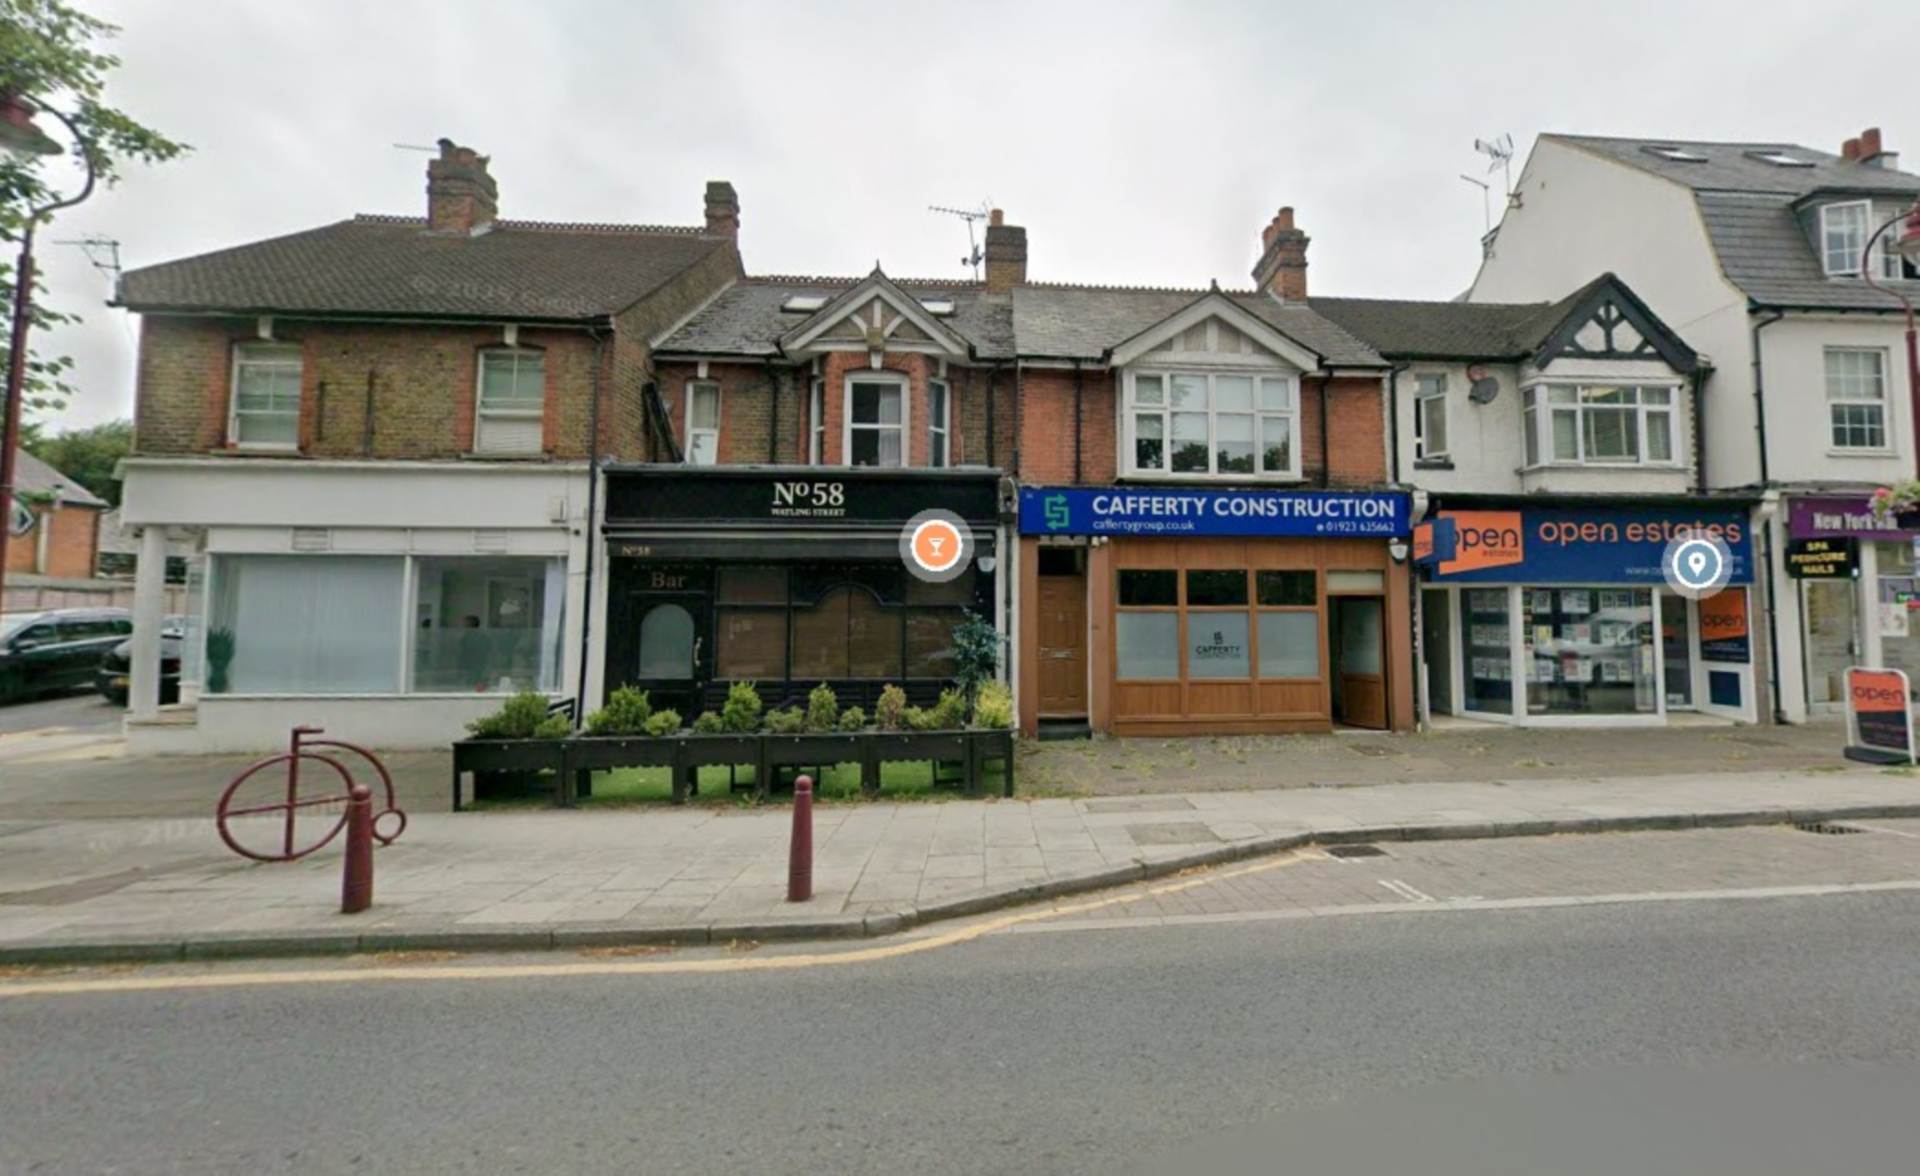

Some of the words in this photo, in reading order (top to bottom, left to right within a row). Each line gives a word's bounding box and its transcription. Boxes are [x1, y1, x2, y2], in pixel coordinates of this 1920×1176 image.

[771, 508, 811, 516] WATLING
[812, 508, 845, 516] STREET
[1092, 495, 1207, 515] CAFFERTY
[1213, 497, 1395, 517] CONSTRUCTION
[1092, 518, 1195, 532] caffertygroup.co.uk
[1326, 521, 1357, 532] 01923
[1813, 512, 1842, 530] New
[1844, 512, 1873, 530] York
[1539, 521, 1619, 546] open
[1625, 519, 1742, 543] estates
[1806, 541, 1829, 551] SPA
[1791, 552, 1847, 563] PEDICURE
[1802, 564, 1835, 574] NAILS
[651, 571, 687, 589] Bar
[1702, 612, 1746, 629] open
[1195, 645, 1240, 656] CAFFERTY
[1854, 686, 1905, 703] open
